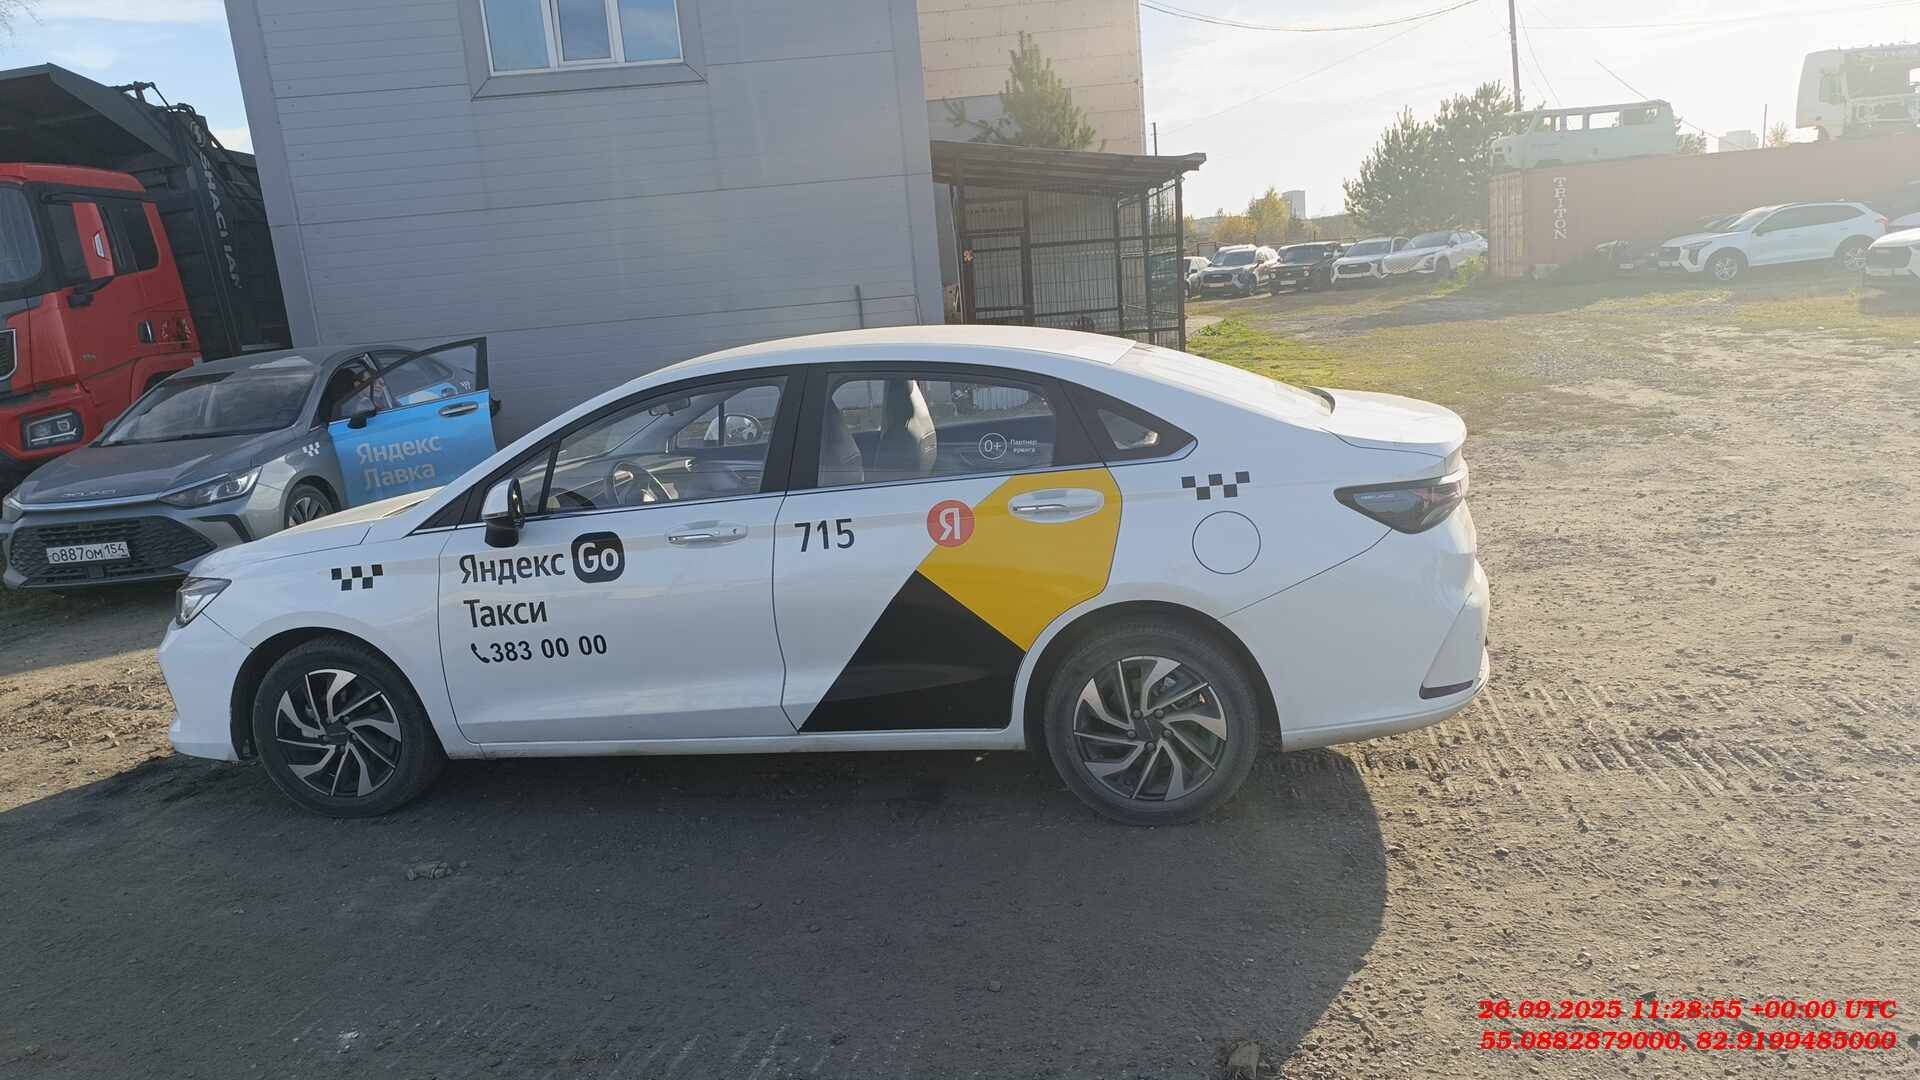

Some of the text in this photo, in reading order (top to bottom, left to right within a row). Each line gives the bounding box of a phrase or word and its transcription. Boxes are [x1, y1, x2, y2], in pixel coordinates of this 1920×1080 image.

[1553, 176, 1567, 240] TRITON
[356, 435, 442, 465] Яндекс
[984, 439, 1002, 452] 0+
[364, 463, 436, 491] Лавка
[794, 517, 856, 553] 715
[939, 507, 961, 541] Я
[459, 541, 620, 586] Яндекс Go
[463, 597, 548, 629] Такси
[489, 634, 608, 663] 383 00 00
